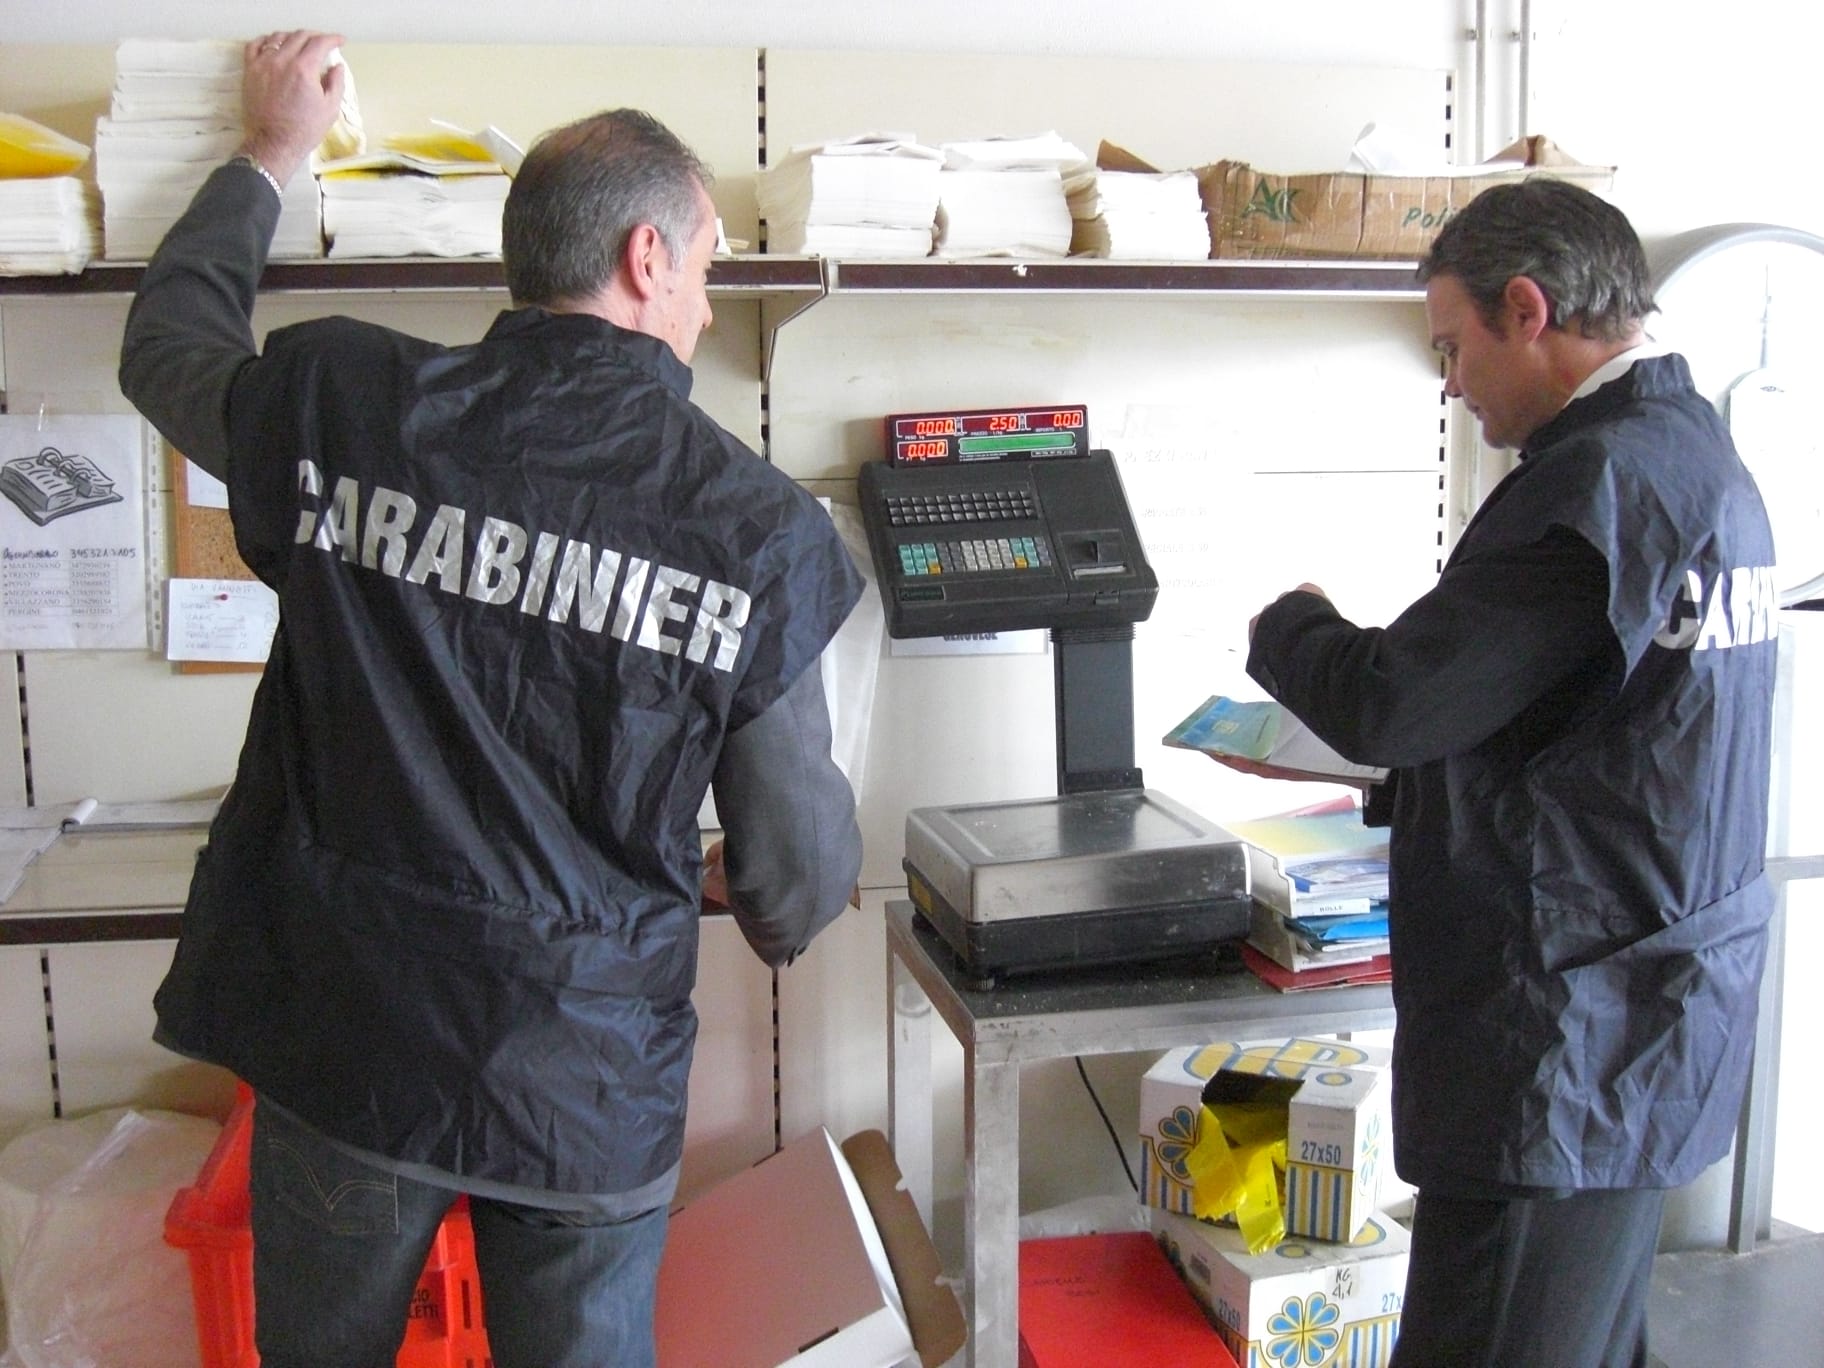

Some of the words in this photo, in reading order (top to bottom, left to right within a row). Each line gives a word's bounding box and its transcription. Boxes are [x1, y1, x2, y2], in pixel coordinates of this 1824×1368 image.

[989, 416, 1018, 431] 2.50
[1053, 413, 1081, 427] 0.00
[907, 442, 945, 457] 0.000
[1302, 1141, 1342, 1165] 27x50
